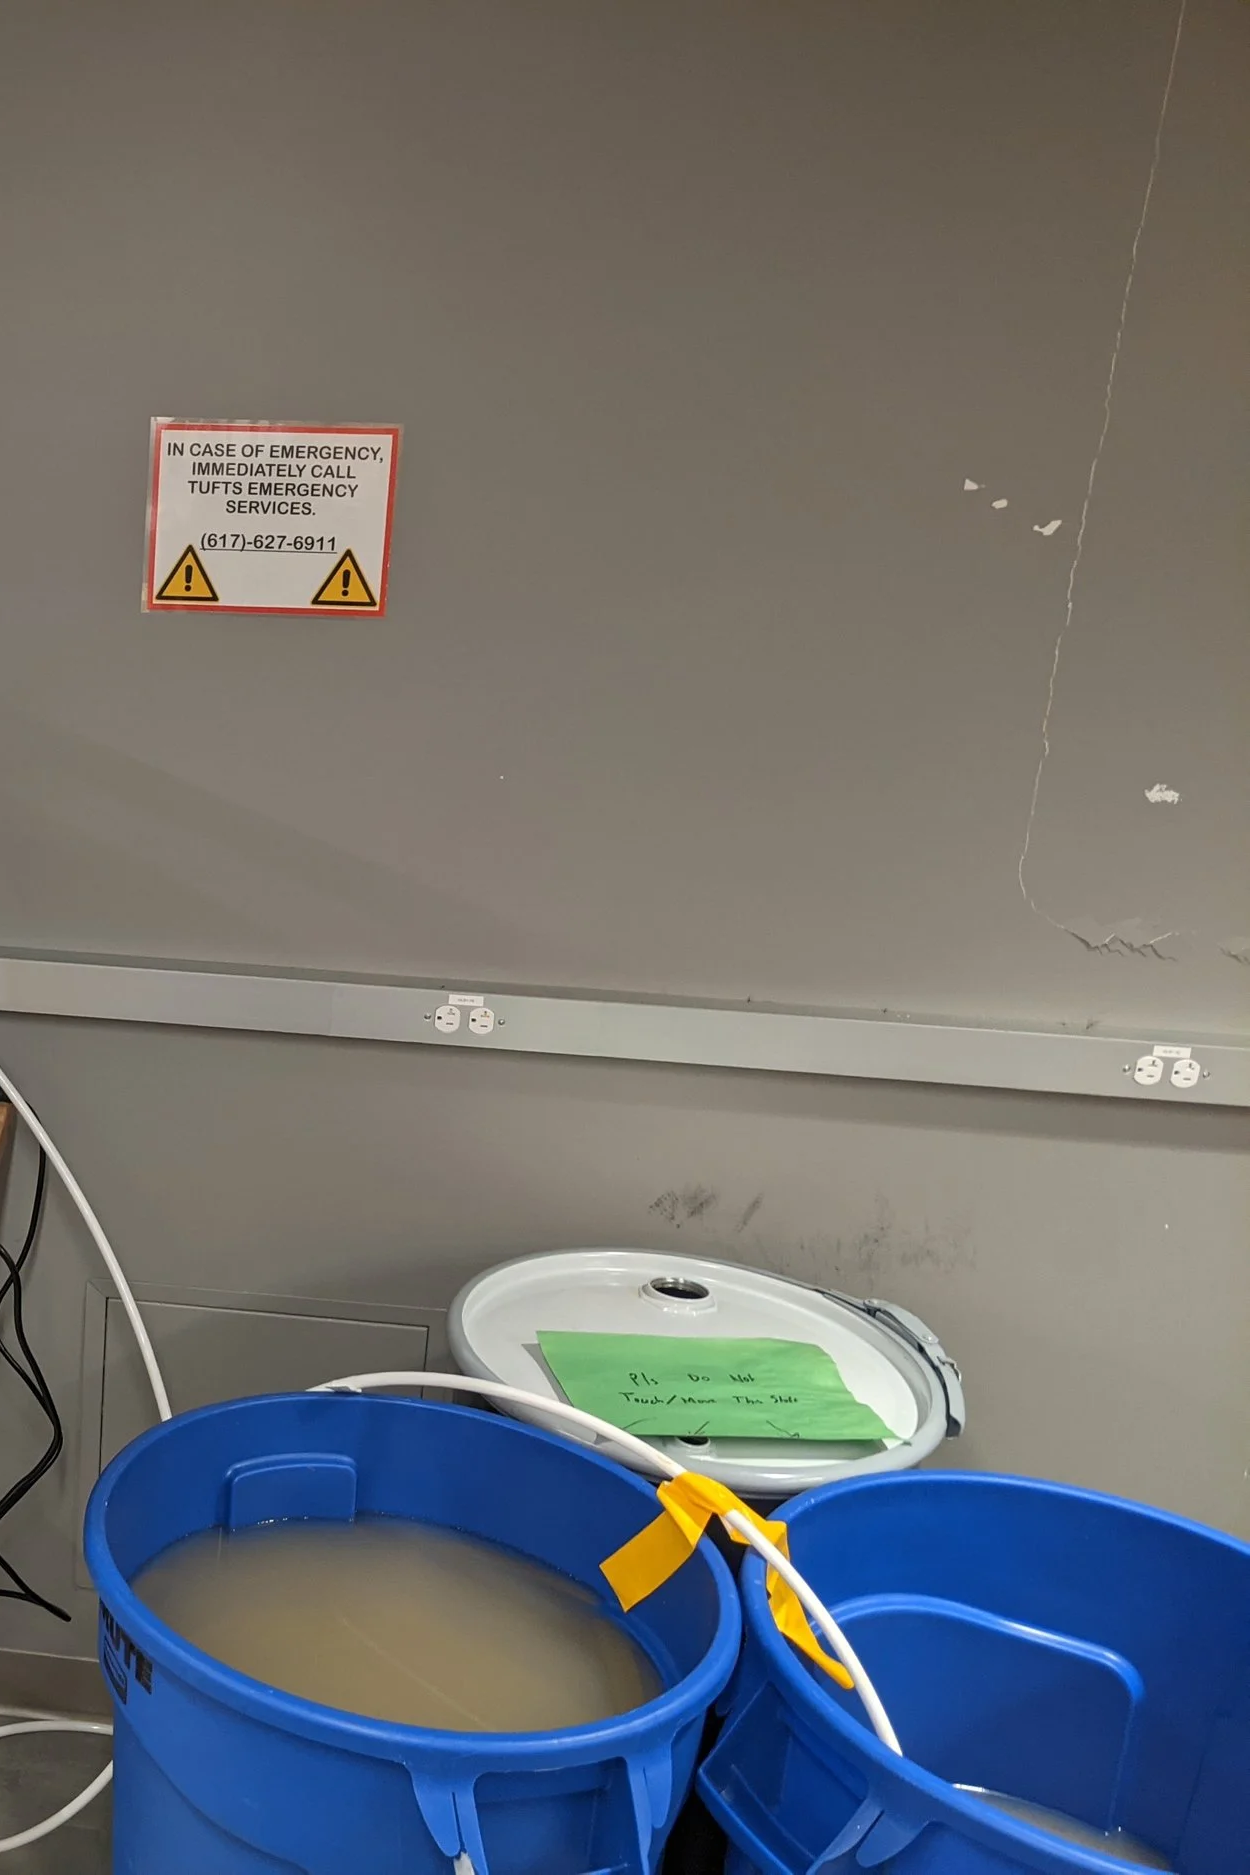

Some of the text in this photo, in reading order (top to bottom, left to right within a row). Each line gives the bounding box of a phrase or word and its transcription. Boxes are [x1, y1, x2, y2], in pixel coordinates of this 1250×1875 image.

[166, 442, 384, 463] IN CASE OF EMERGENCY,
[191, 462, 356, 479] IMMEDIATELY CALL
[188, 480, 359, 498] TUFTS EMERGENCY
[225, 500, 316, 516] SERVICES.
[200, 533, 337, 553] (617)-627-6911
[687, 1373, 710, 1382] Do
